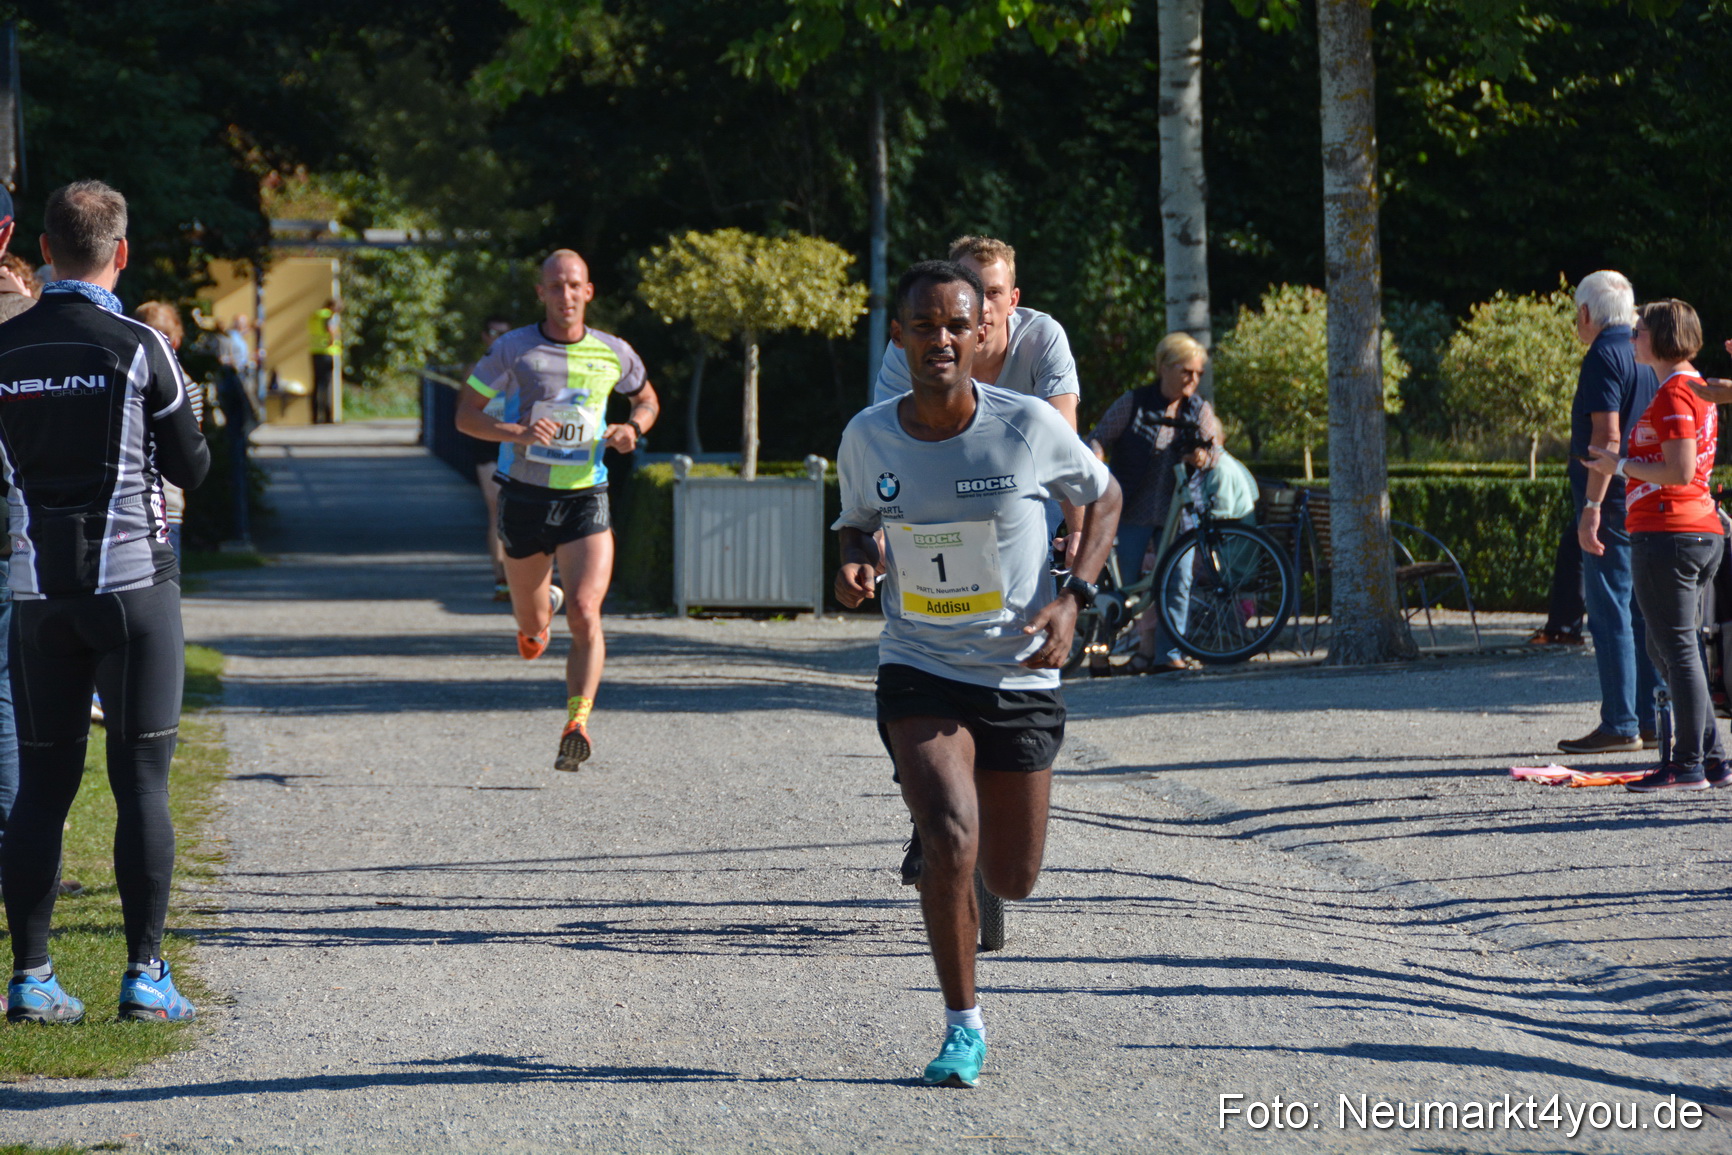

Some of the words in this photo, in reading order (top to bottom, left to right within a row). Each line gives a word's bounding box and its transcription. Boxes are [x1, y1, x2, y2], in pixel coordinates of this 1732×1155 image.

[51, 388, 106, 397] GROUP
[956, 475, 1017, 494] BOCK
[913, 532, 962, 545] BOCK
[931, 553, 947, 582] 1
[916, 585, 935, 594] PARTL
[927, 601, 971, 614] Addisu
